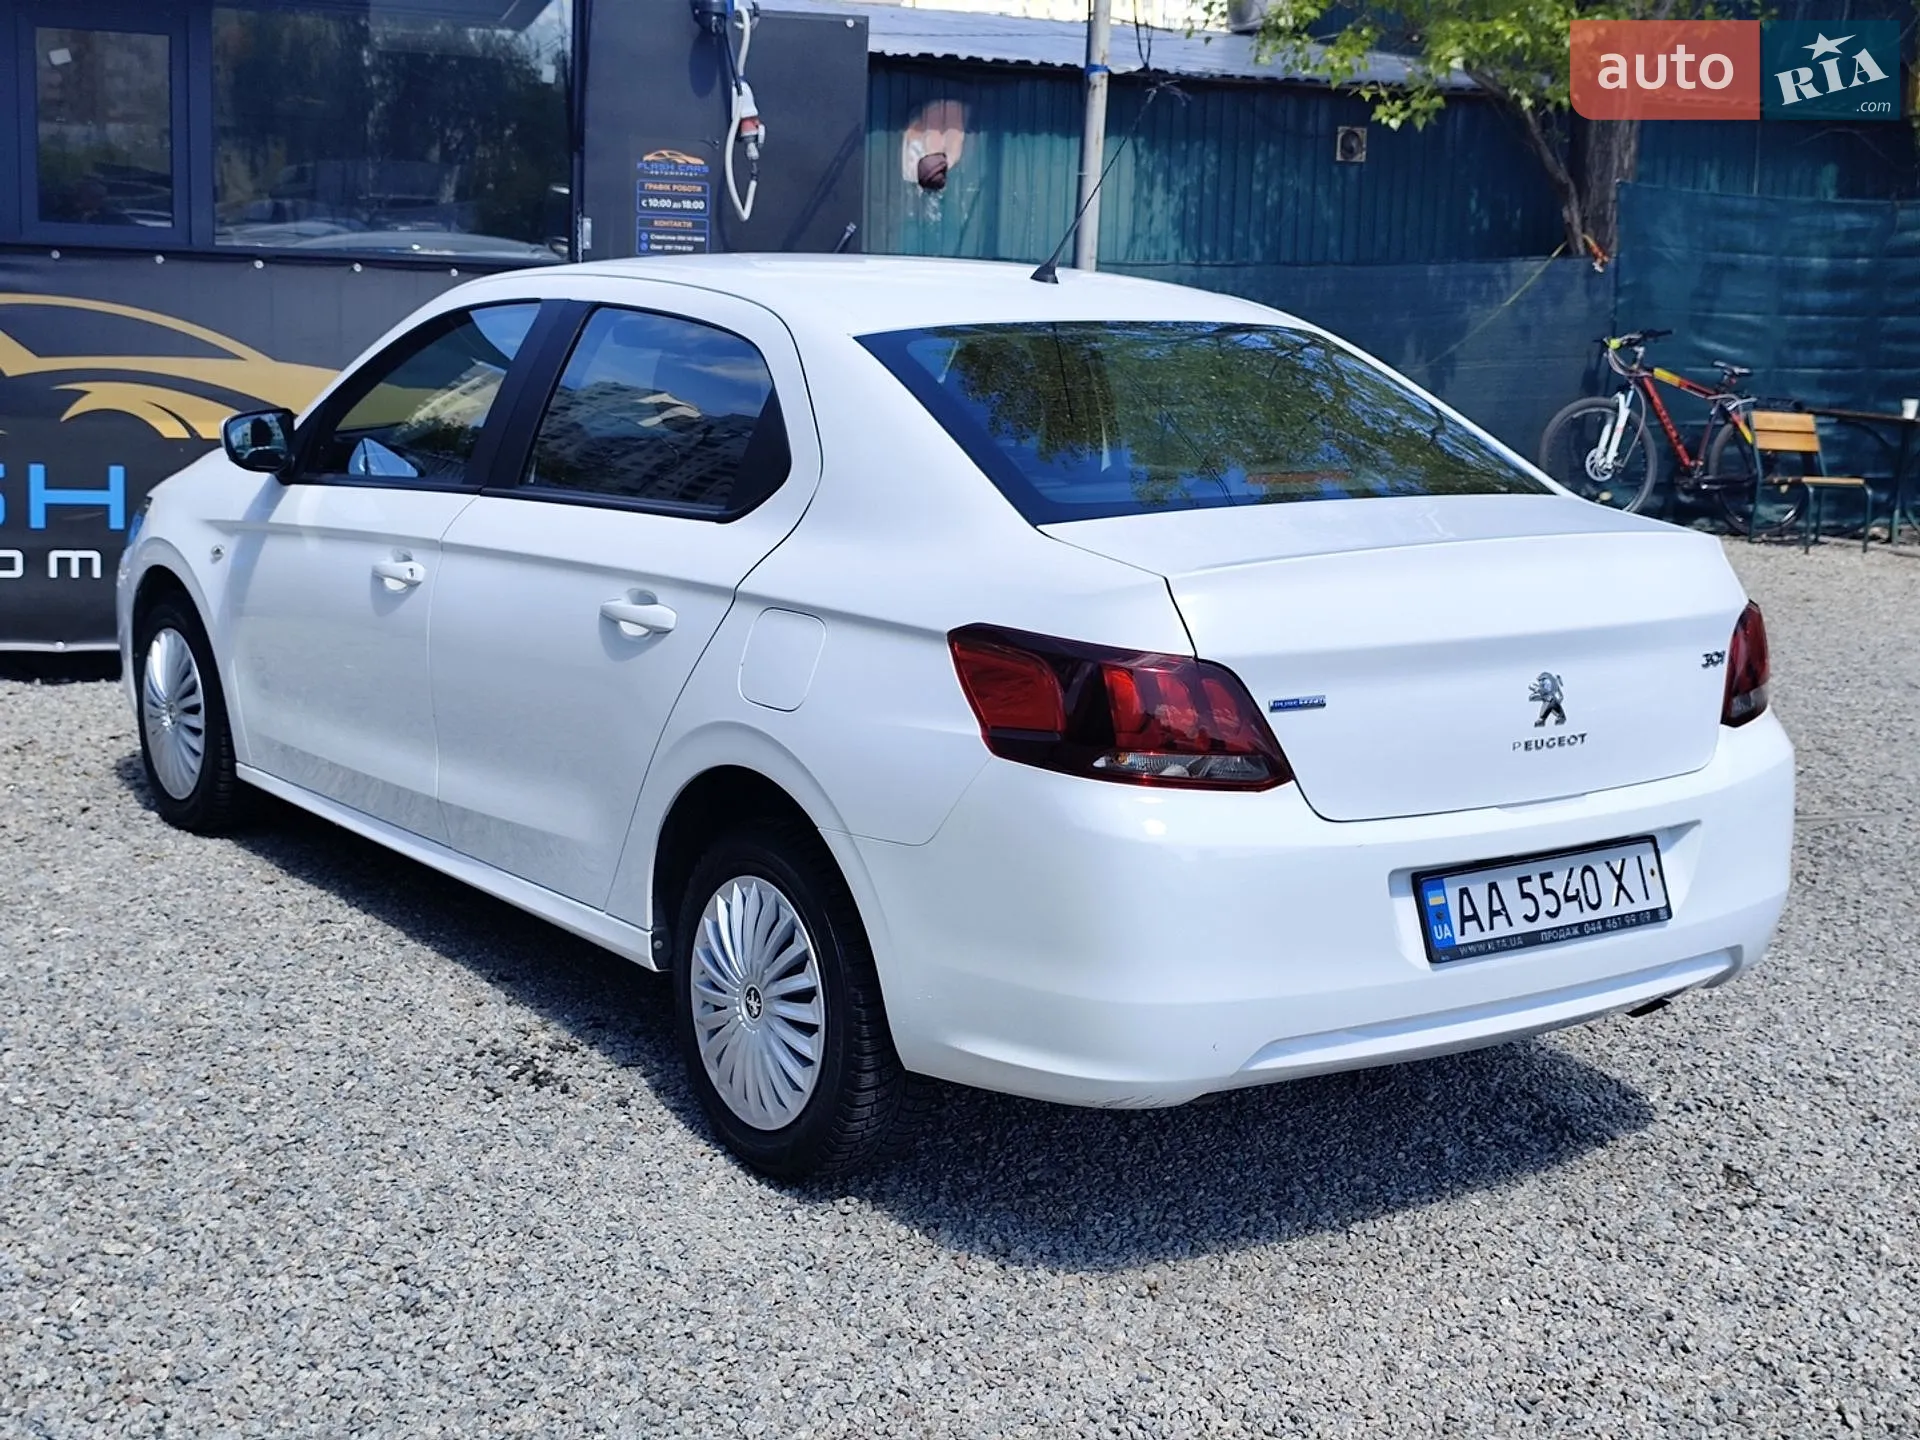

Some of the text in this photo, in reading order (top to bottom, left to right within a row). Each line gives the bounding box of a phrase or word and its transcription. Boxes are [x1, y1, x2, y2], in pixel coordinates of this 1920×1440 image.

[637, 162, 709, 173] FLASH CARS
[648, 198, 672, 208] 10:00
[681, 200, 705, 210] 18:00
[1512, 733, 1587, 751] PEUGEOT
[1458, 881, 1513, 936] AA
[1517, 864, 1602, 923] 5540
[1433, 924, 1452, 941] UA
[1540, 926, 1581, 942] ПРОДАЖ
[1584, 921, 1602, 935] 044
